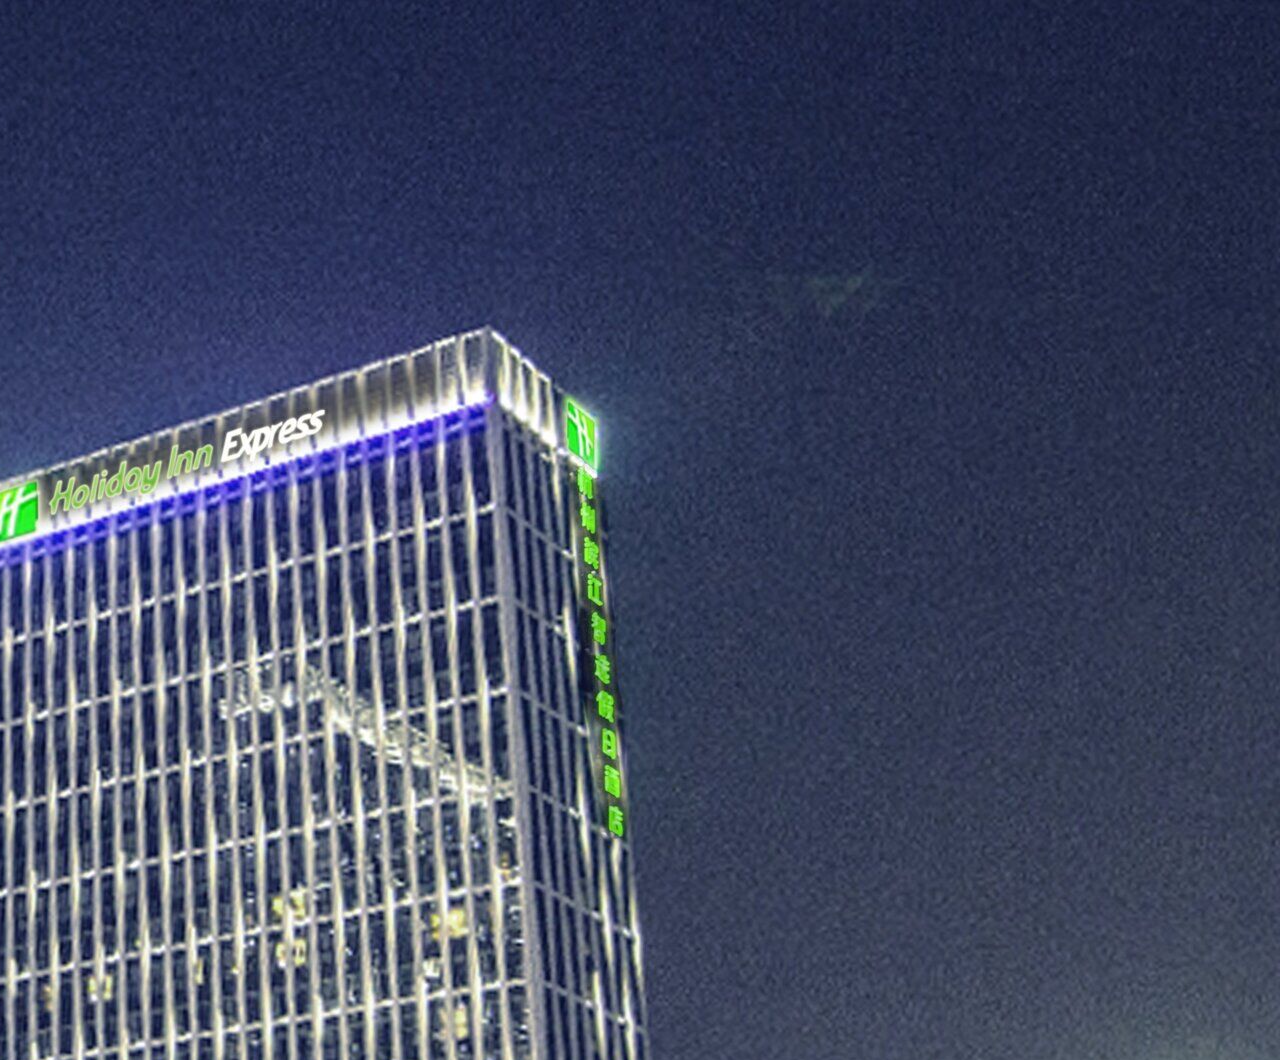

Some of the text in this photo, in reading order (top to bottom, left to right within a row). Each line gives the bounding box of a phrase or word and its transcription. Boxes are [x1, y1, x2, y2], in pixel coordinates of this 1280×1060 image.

[49, 409, 325, 514] Holiday Inn Express
